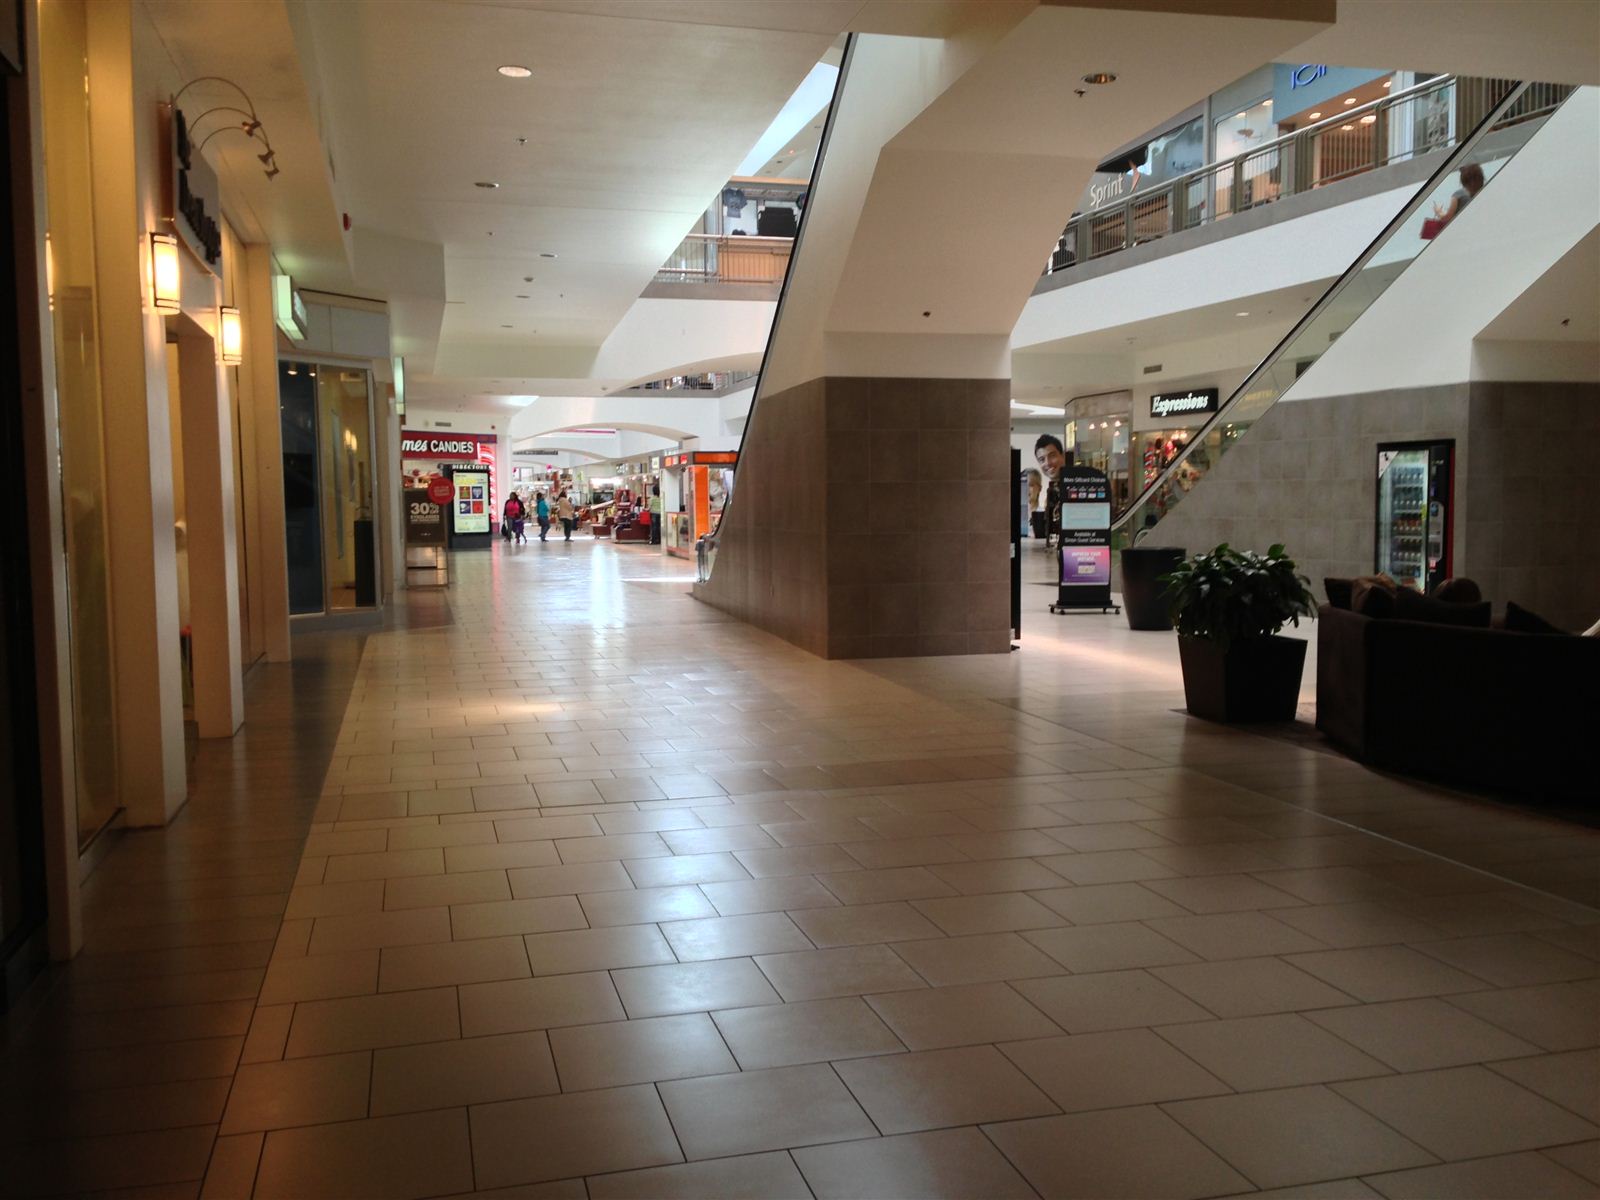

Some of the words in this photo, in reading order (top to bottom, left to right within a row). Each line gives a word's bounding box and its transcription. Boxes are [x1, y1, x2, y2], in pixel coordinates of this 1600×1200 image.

[1090, 172, 1123, 209] Sprint
[1151, 392, 1209, 417] Expressions
[402, 439, 428, 452] mes
[430, 440, 474, 453] CANDIES
